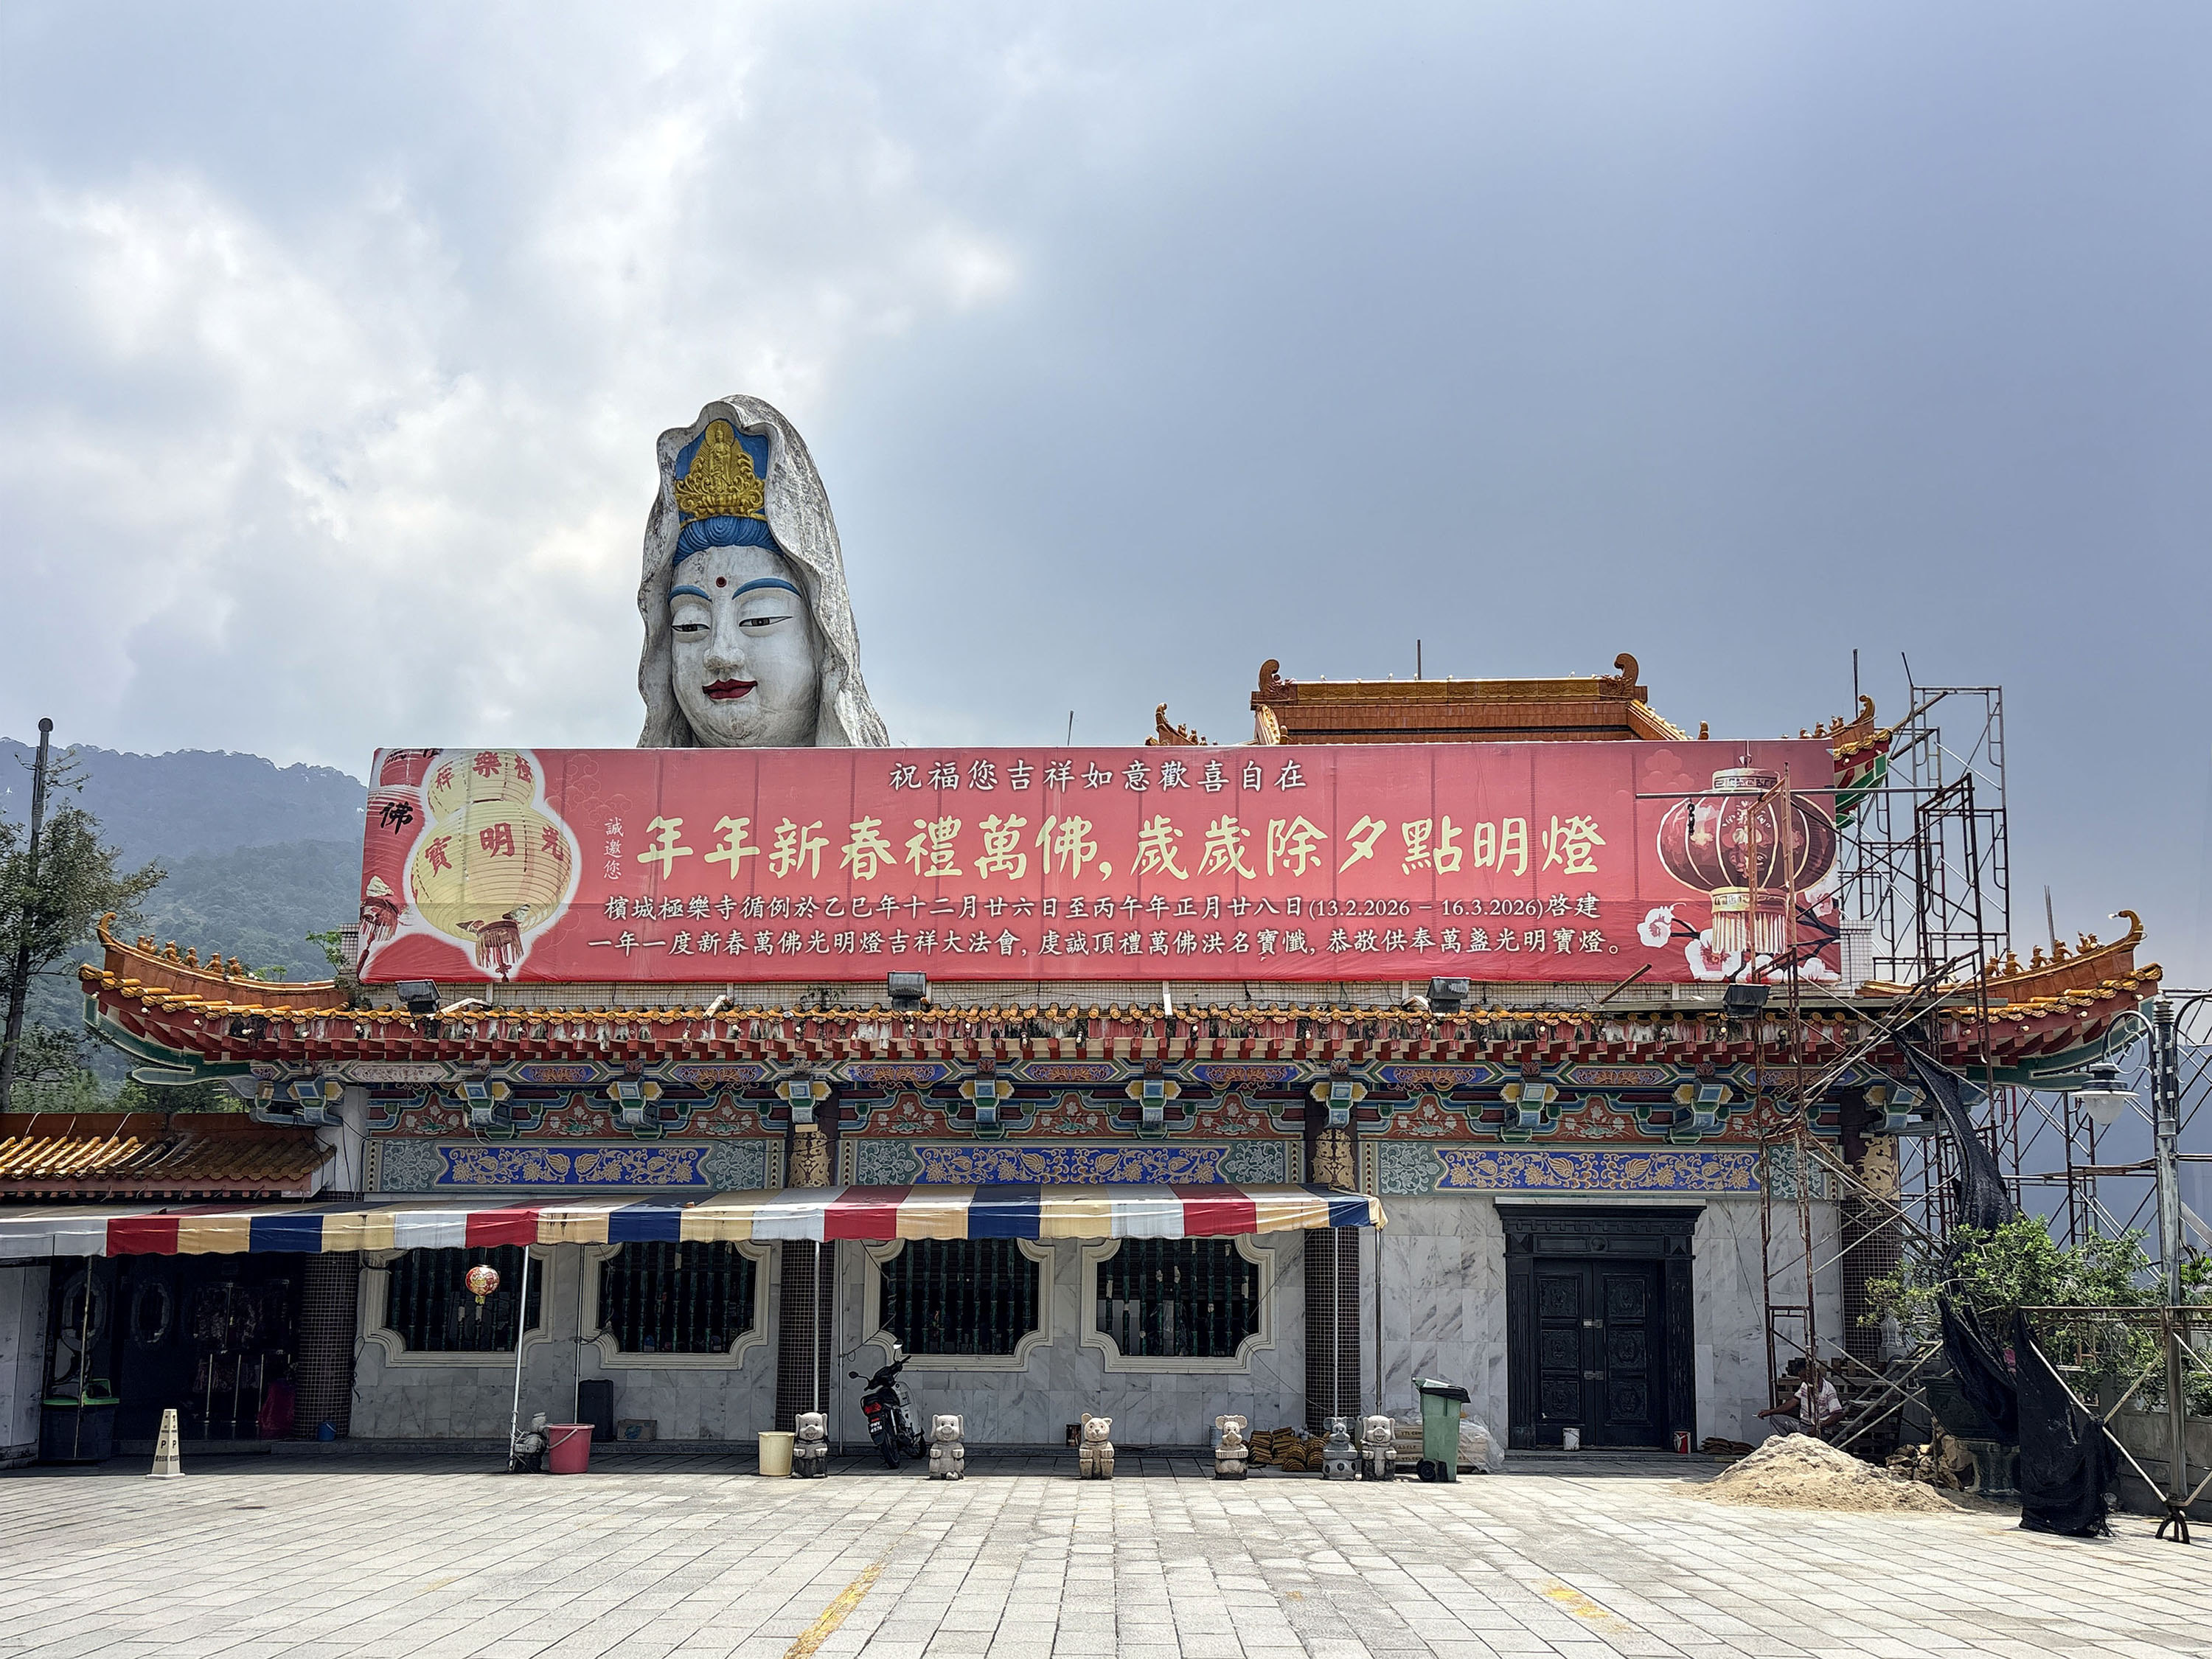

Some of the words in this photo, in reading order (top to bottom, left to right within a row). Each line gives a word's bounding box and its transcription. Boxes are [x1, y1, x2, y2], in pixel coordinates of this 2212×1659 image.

[888, 759, 1307, 792] 祝福您吉祥如意歡喜自在
[380, 801, 414, 835] 佛
[603, 816, 625, 880] 誠邀您
[161, 1440, 167, 1449] P
[173, 1440, 177, 1449] P
